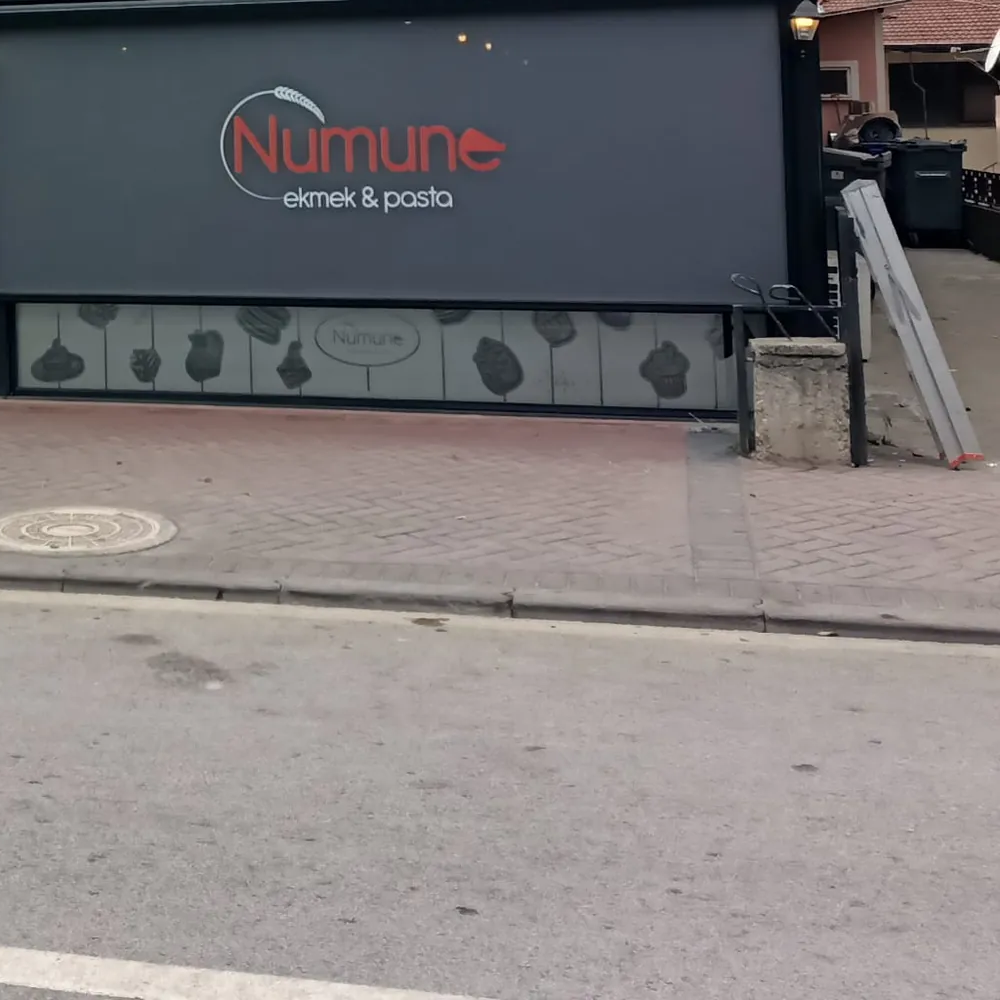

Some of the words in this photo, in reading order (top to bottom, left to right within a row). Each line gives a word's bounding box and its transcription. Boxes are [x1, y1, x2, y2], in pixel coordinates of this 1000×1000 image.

[233, 113, 507, 174] Numune
[283, 186, 357, 209] ekmek
[361, 185, 380, 209] &
[383, 185, 454, 214] pasta
[332, 328, 405, 347] Numune
